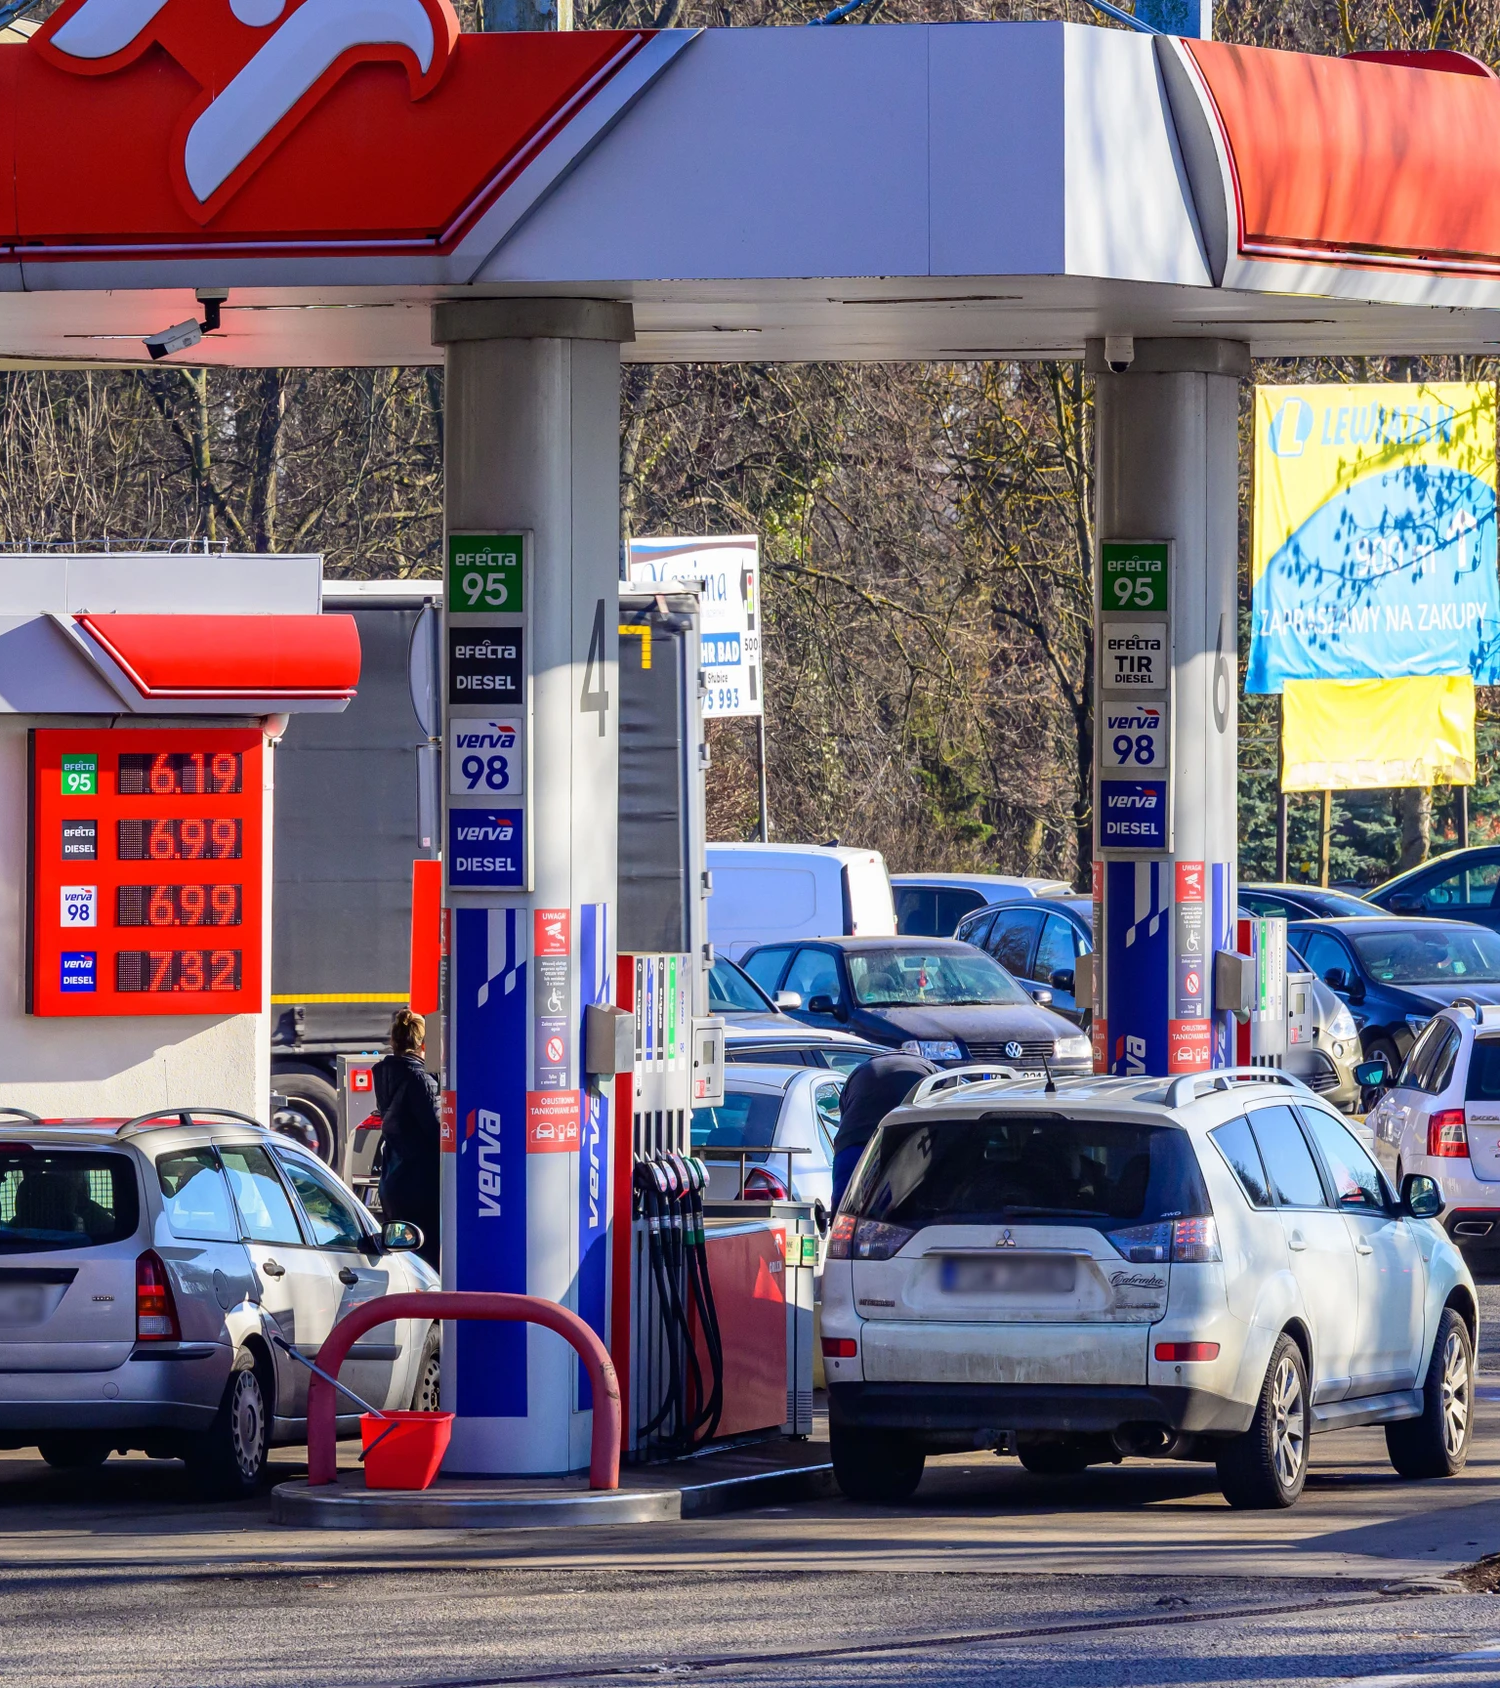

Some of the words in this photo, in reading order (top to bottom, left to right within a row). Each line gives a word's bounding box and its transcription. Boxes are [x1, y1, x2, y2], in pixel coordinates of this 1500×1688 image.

[1320, 400, 1454, 446] LEWIATAN
[455, 547, 517, 567] efecta
[1107, 556, 1162, 572] efecta
[1355, 536, 1404, 576] 900
[462, 572, 508, 606] 95
[1113, 577, 1155, 607] 95
[1260, 605, 1381, 637] ZAPRASZAMY
[1385, 607, 1414, 632] NA
[1417, 602, 1488, 631] ZAKUPY
[455, 640, 517, 659] efecta
[717, 640, 741, 663] BAD
[744, 638, 759, 651] 500
[1108, 634, 1161, 651] efecta
[579, 598, 609, 737] 4
[1114, 655, 1153, 674] TIR
[1212, 612, 1231, 734] 6
[455, 675, 516, 691] DIESEL
[1114, 674, 1154, 684] DIESEL
[718, 687, 740, 709] 993
[1107, 713, 1160, 730] verva
[456, 730, 516, 749] verva
[1112, 734, 1156, 765] 98
[63, 761, 95, 771] efecta
[150, 753, 238, 794] 6.19
[461, 755, 510, 790] 98
[67, 773, 91, 792] 95
[1107, 792, 1158, 809] verva
[63, 826, 95, 838] efecta
[456, 823, 514, 842] verva
[1106, 821, 1159, 836] DIESEL
[149, 818, 238, 860] 6.99
[64, 844, 95, 854] DIESEL
[455, 857, 516, 873] DIESEL
[64, 890, 92, 902] verva
[149, 885, 237, 926] 6.99
[67, 904, 90, 922] 98
[63, 957, 93, 969] verva
[149, 950, 236, 992] 7.32
[63, 975, 94, 985] DIESEL
[530, 1107, 569, 1116] TANKOWANE
[476, 1109, 502, 1218] verva
[588, 1089, 600, 1229] verva
